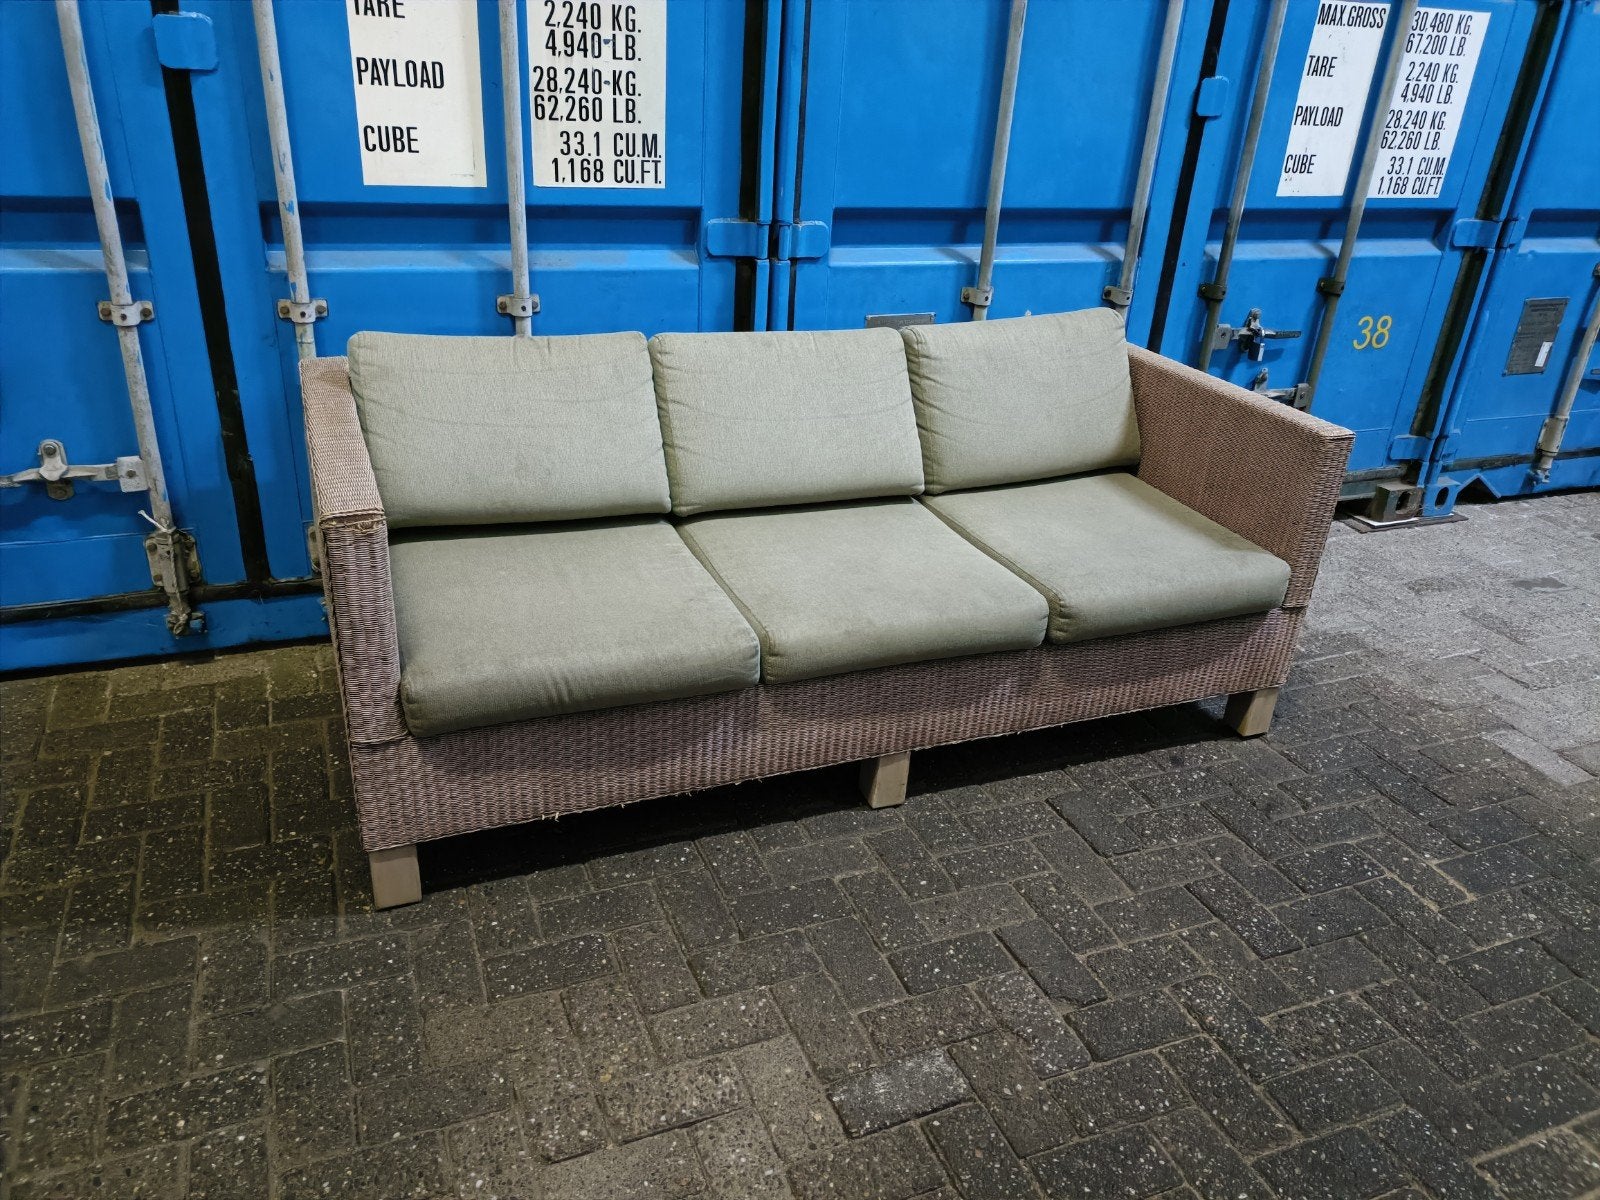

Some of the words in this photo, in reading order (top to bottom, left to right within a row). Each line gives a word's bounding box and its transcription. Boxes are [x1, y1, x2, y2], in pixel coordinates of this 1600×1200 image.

[544, 0, 602, 30] 2,240
[611, 4, 642, 33] KG.
[1317, 3, 1386, 28] MAX.GROSS
[1411, 10, 1453, 34] 30,480
[1455, 14, 1472, 35] KG.
[545, 29, 602, 58] 4,940
[612, 34, 642, 61] LB.
[1405, 33, 1447, 55] 67,200
[1449, 36, 1467, 57] LB.
[356, 57, 445, 89] PAYLOAD
[1306, 55, 1338, 77] TARE
[1405, 61, 1440, 83] 2,240
[1442, 63, 1459, 84] KG.
[533, 66, 603, 95] 28,240
[612, 70, 642, 97] KG.
[1400, 82, 1434, 104] 4,940
[1437, 84, 1454, 104] LB.
[534, 94, 603, 123] 62,260
[612, 98, 642, 124] LB.
[1294, 105, 1344, 127] PAYLOAD
[1385, 109, 1428, 130] 28,240
[1429, 111, 1446, 131] KG.
[363, 125, 420, 154] CUBE
[559, 131, 601, 157] 33.1
[613, 133, 662, 159] CU.M.
[1380, 131, 1422, 150] 62,260
[1424, 131, 1441, 151] LB.
[551, 158, 604, 184] 1,168
[613, 159, 662, 184] CU.FT.
[1284, 154, 1317, 174] CUBE
[1387, 156, 1414, 176] 33.1
[1416, 157, 1446, 176] CU.M.
[1377, 176, 1410, 195] 1,168
[1353, 315, 1393, 350] 38
